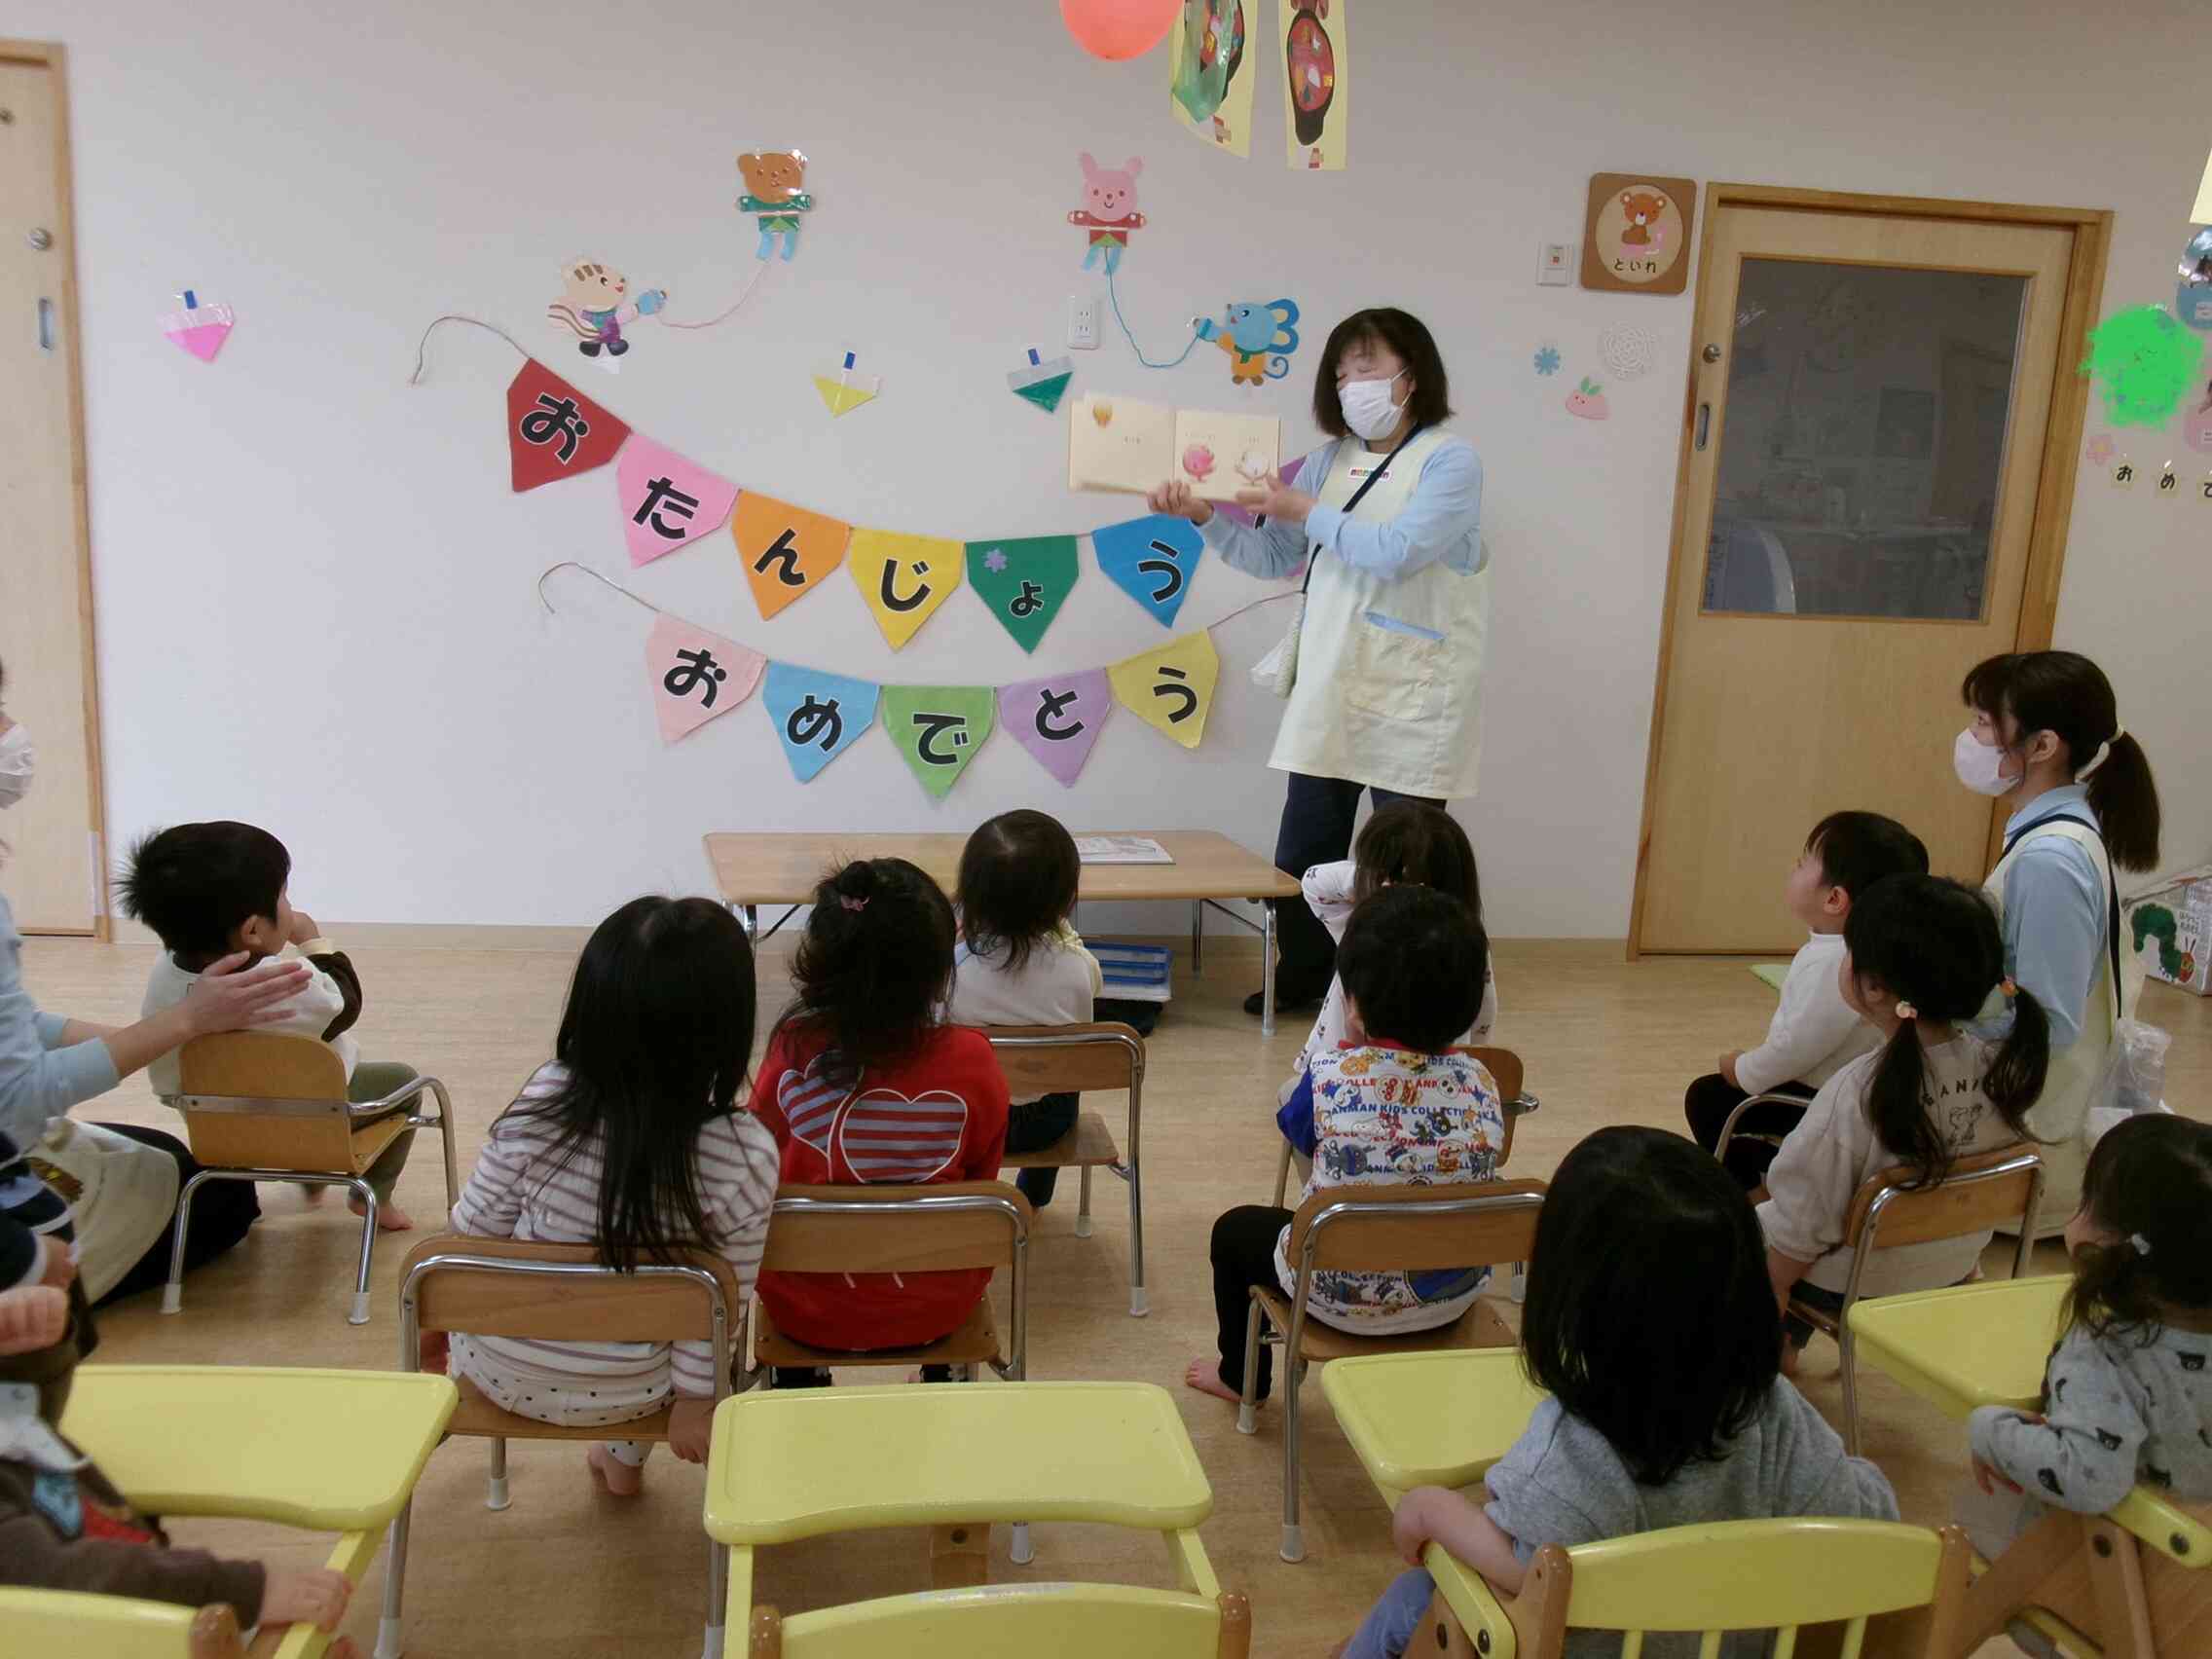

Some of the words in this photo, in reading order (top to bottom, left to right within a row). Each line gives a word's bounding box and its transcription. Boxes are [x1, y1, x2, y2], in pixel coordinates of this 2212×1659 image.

[1614, 258, 1657, 274] といれ
[520, 389, 1267, 619] おたんじょう
[664, 647, 1199, 766] おめでとう
